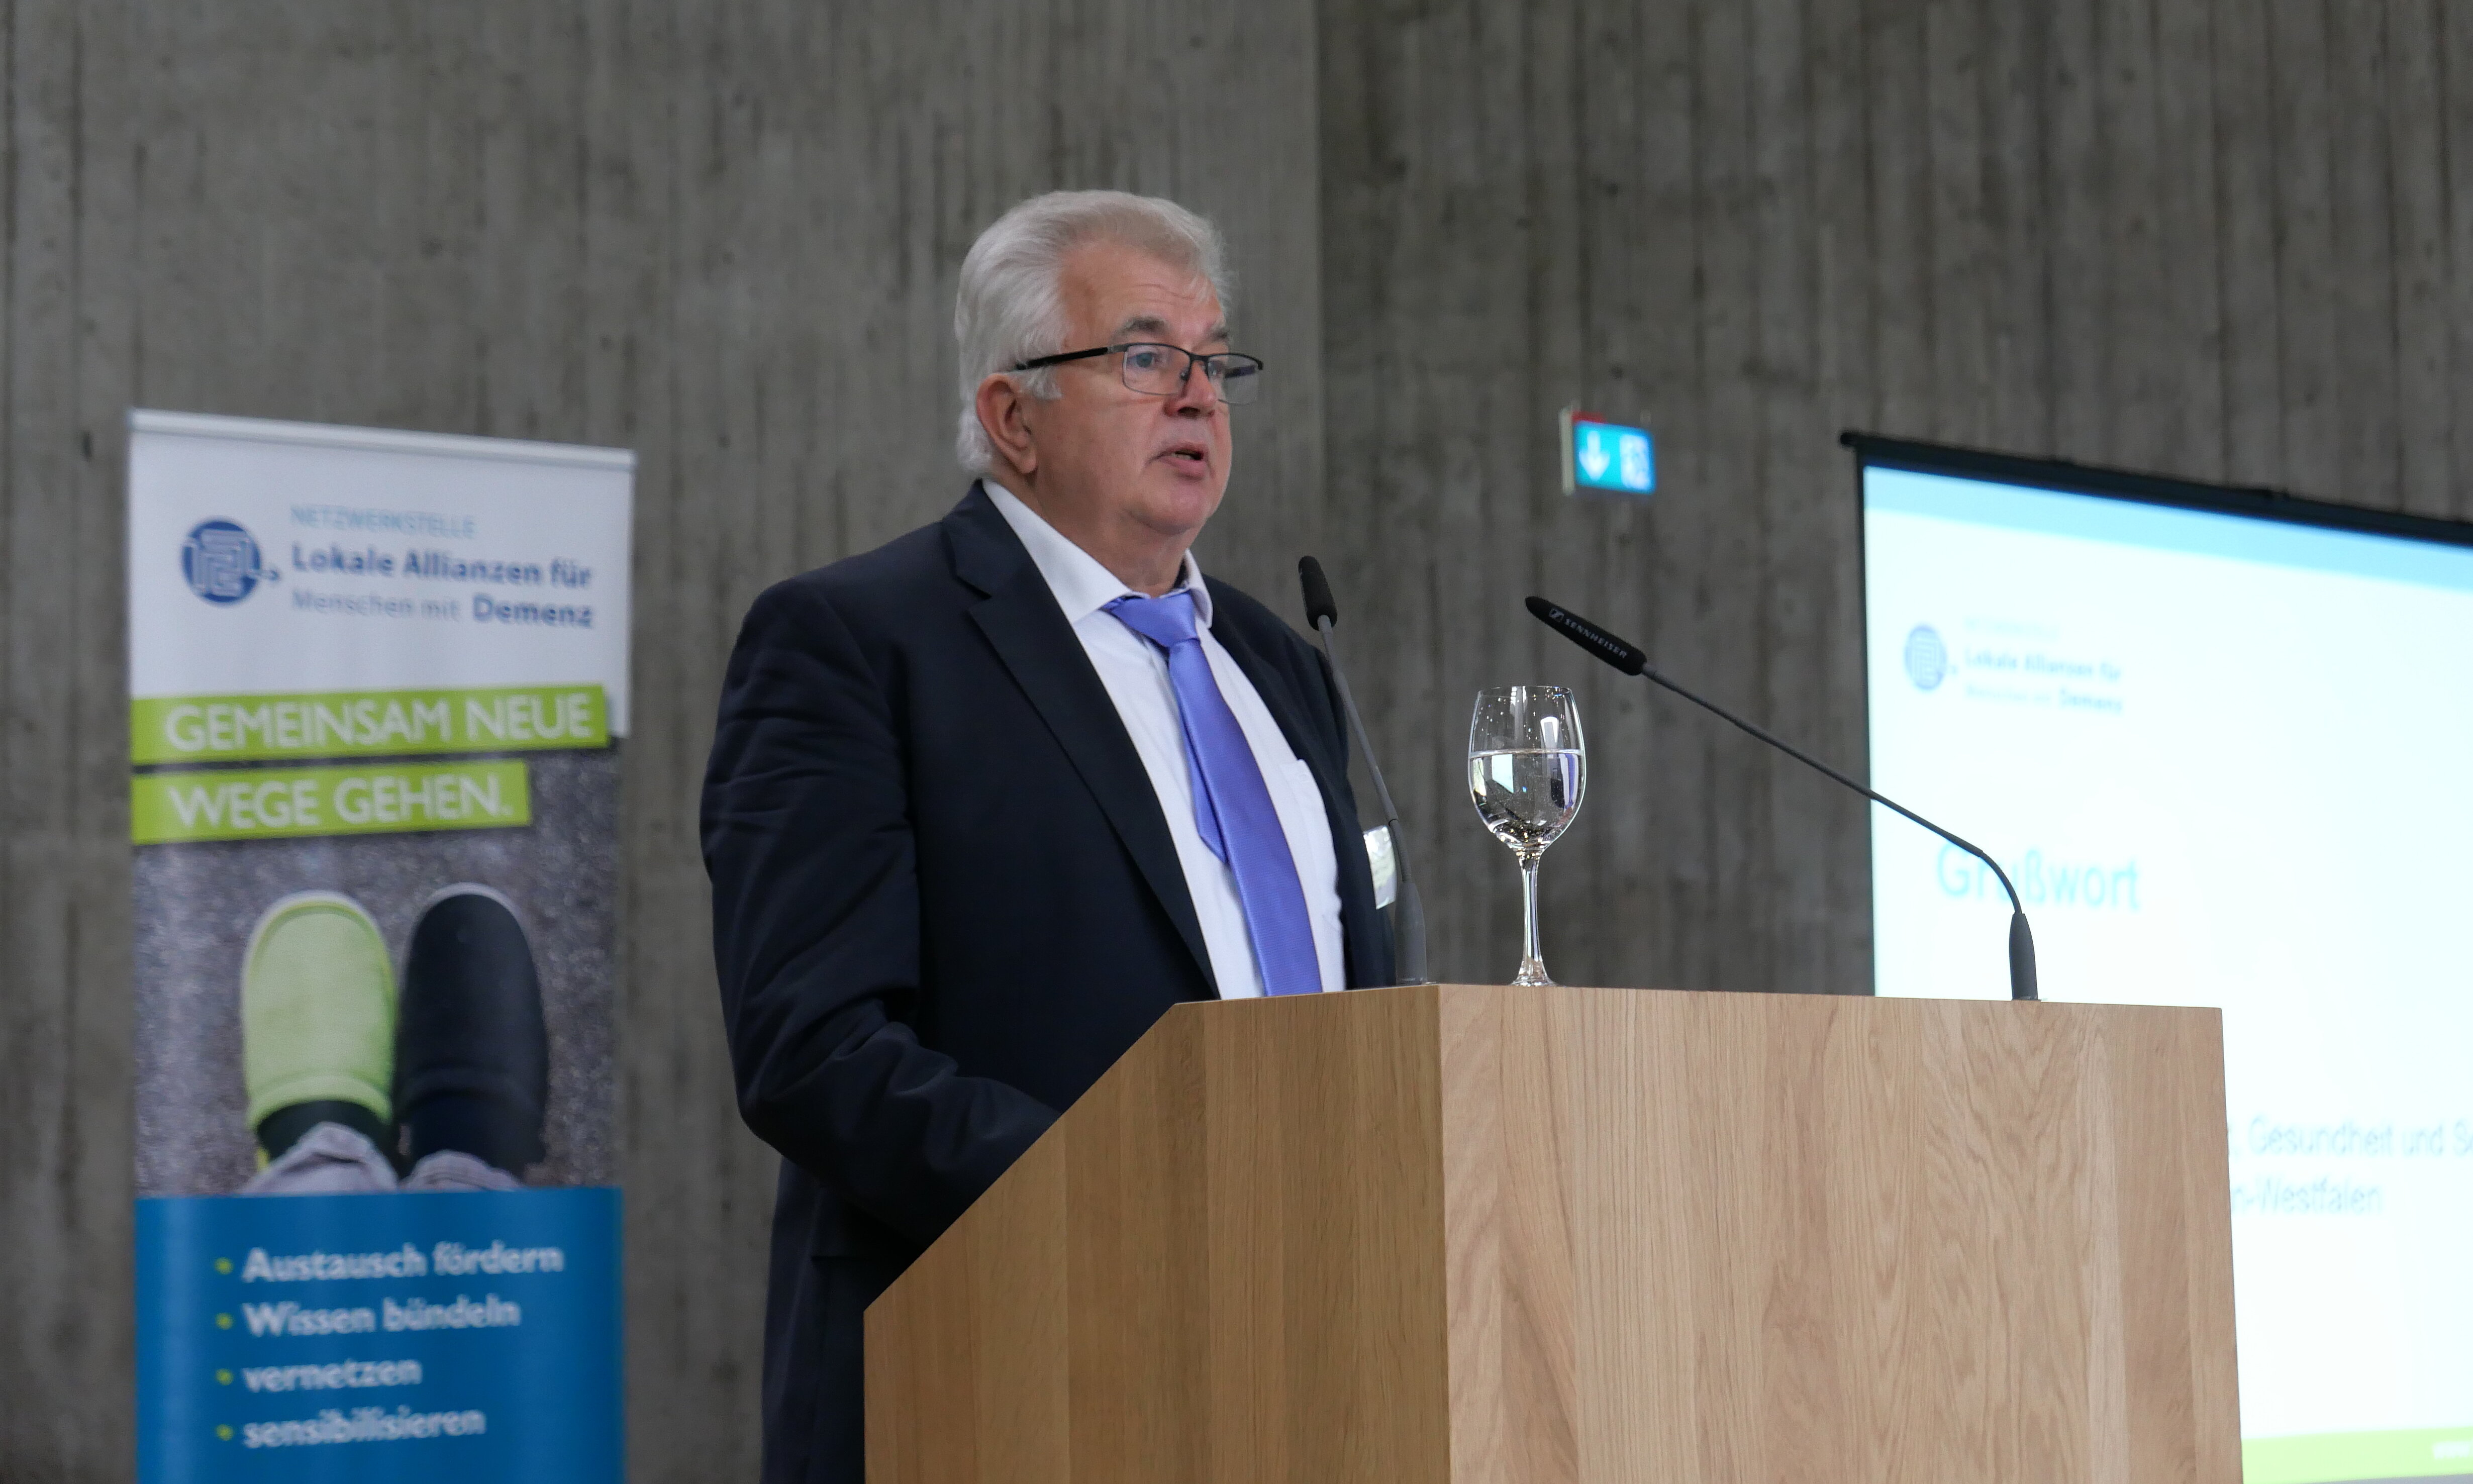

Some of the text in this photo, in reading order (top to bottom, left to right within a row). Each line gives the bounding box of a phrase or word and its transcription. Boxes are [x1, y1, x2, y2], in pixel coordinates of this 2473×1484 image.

[291, 507, 475, 538] NETZWERKSTELLE
[292, 543, 591, 587] Lokale Allianzen für
[292, 589, 593, 628] Menschen mit Demenz
[164, 692, 593, 752] GEMEINSAM NEUE
[167, 772, 514, 830] WEGE GEHEN.
[2248, 1112, 2394, 1157] Gesundheit
[2402, 1119, 2444, 1157] und
[242, 1240, 564, 1282] Austausch fördern
[242, 1294, 521, 1337] Wissen bündeln
[242, 1358, 423, 1393] vernetzen
[242, 1405, 486, 1448] sensibilisieren
